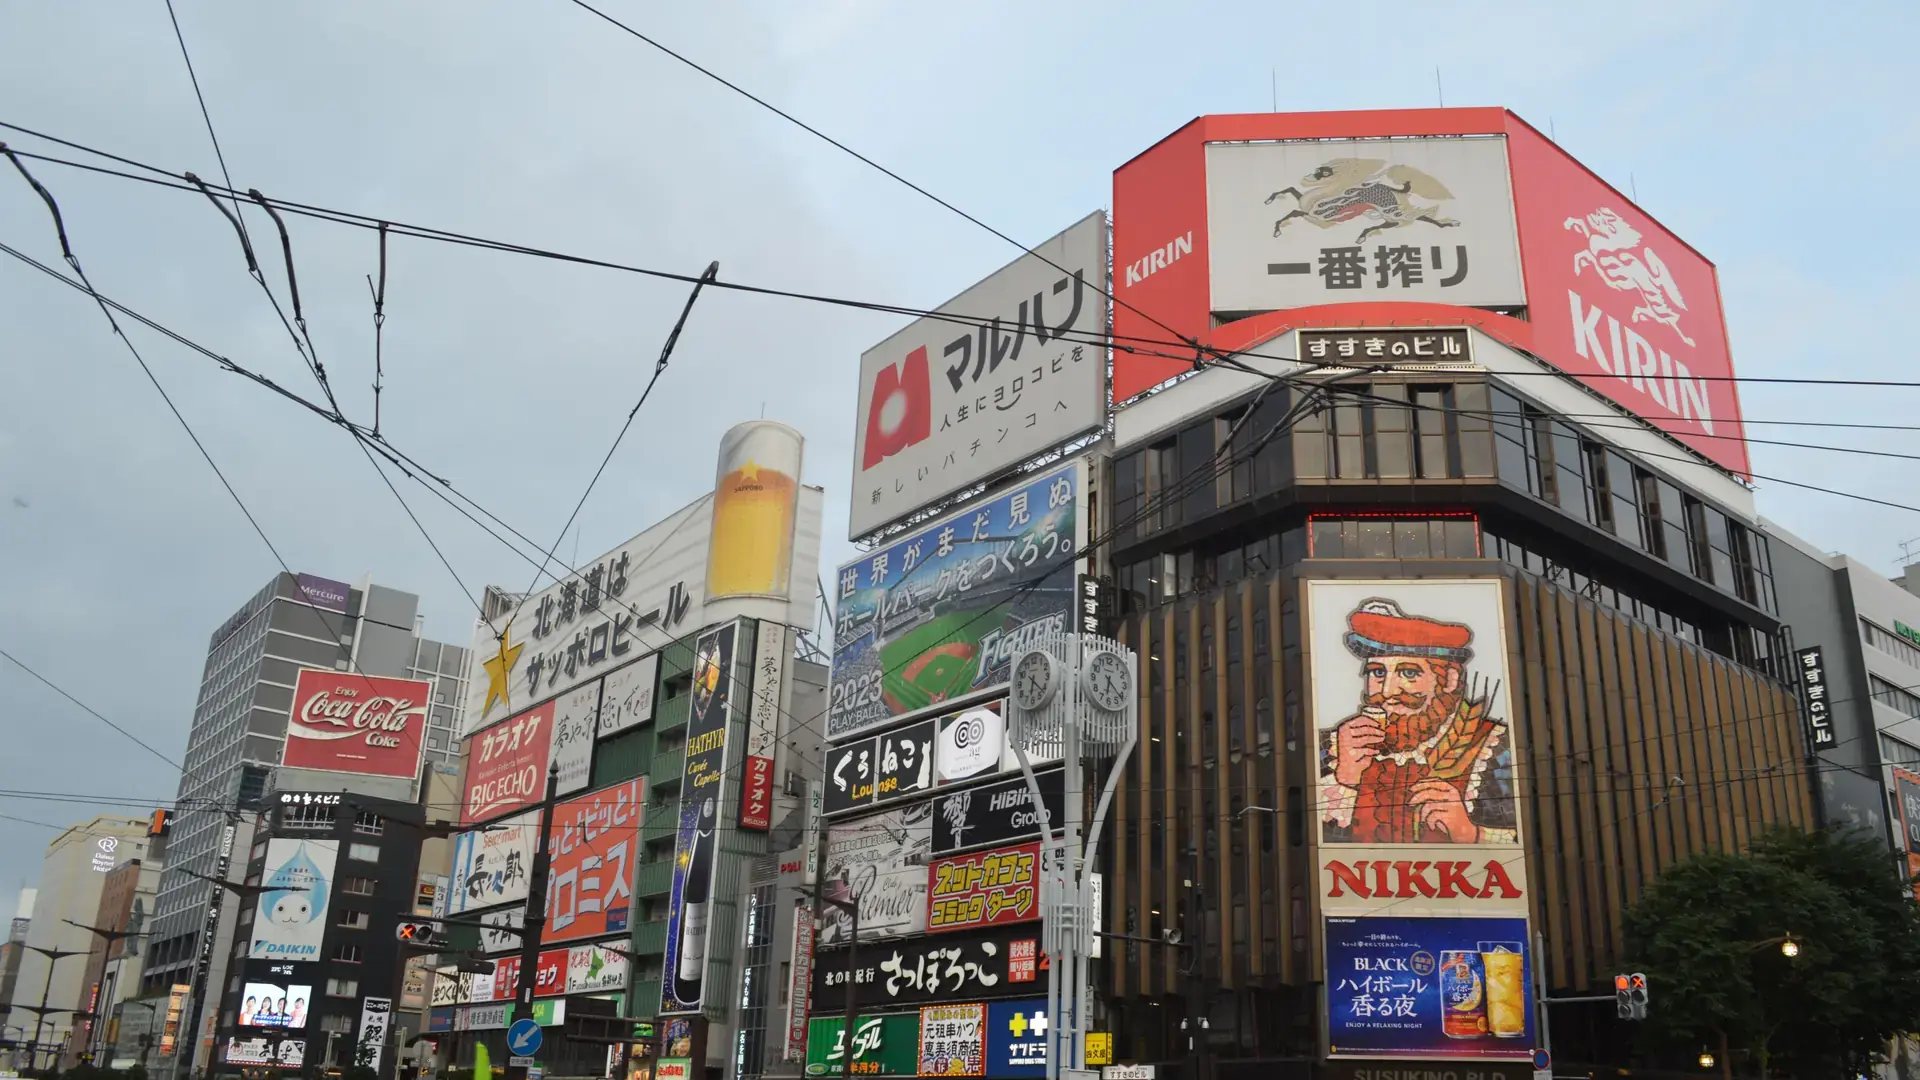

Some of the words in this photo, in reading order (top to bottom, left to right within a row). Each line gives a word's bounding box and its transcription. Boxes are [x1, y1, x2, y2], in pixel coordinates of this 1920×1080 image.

[1125, 231, 1193, 288] KIRIN
[1267, 244, 1468, 290] 一番搾り
[943, 268, 1084, 394] マルハン
[1307, 336, 1462, 359] すすきのビル
[1568, 288, 1714, 438] KIRIN
[940, 345, 1084, 433] 人生にヨロコビを
[870, 400, 1067, 505] 新しいパチンコへ
[840, 476, 1072, 598] 世界がまだ見ぬ
[300, 585, 344, 602] Mercure
[532, 551, 630, 640] 北海道は
[837, 523, 1072, 636] ボールパークをつくろう。
[527, 581, 692, 697] サッポロビール
[972, 609, 1070, 688] FIGHTERS
[301, 691, 413, 733] Coca-Cola
[335, 686, 359, 697] Enjoy
[831, 669, 883, 715] 2023
[1802, 652, 1832, 743] すすきのビル
[365, 731, 400, 749] Coke
[479, 716, 541, 764] カラオケ
[830, 713, 853, 732] PLAY
[856, 704, 880, 723] BALL
[687, 727, 725, 757] HATHYR
[750, 759, 768, 815] カラオケ
[833, 738, 915, 792] くろねこ
[469, 782, 496, 816] BIG
[497, 764, 537, 798] ECHO
[852, 776, 897, 800] Lounge
[933, 852, 1034, 897] ネットカフェ
[1324, 859, 1524, 900] NIKKA
[931, 893, 985, 927] コミック
[986, 886, 1033, 920] ダーツ
[266, 944, 316, 955] DAIKIN
[880, 941, 998, 997] さっぽろっこ
[1354, 957, 1409, 972] BLACK
[1336, 975, 1428, 994] ハイボール
[1349, 993, 1418, 1018] 香る夜
[924, 1039, 981, 1057] 恵美須商店
[925, 1022, 974, 1039] 元祖串かつ
[1009, 1042, 1046, 1057] サツドラ
